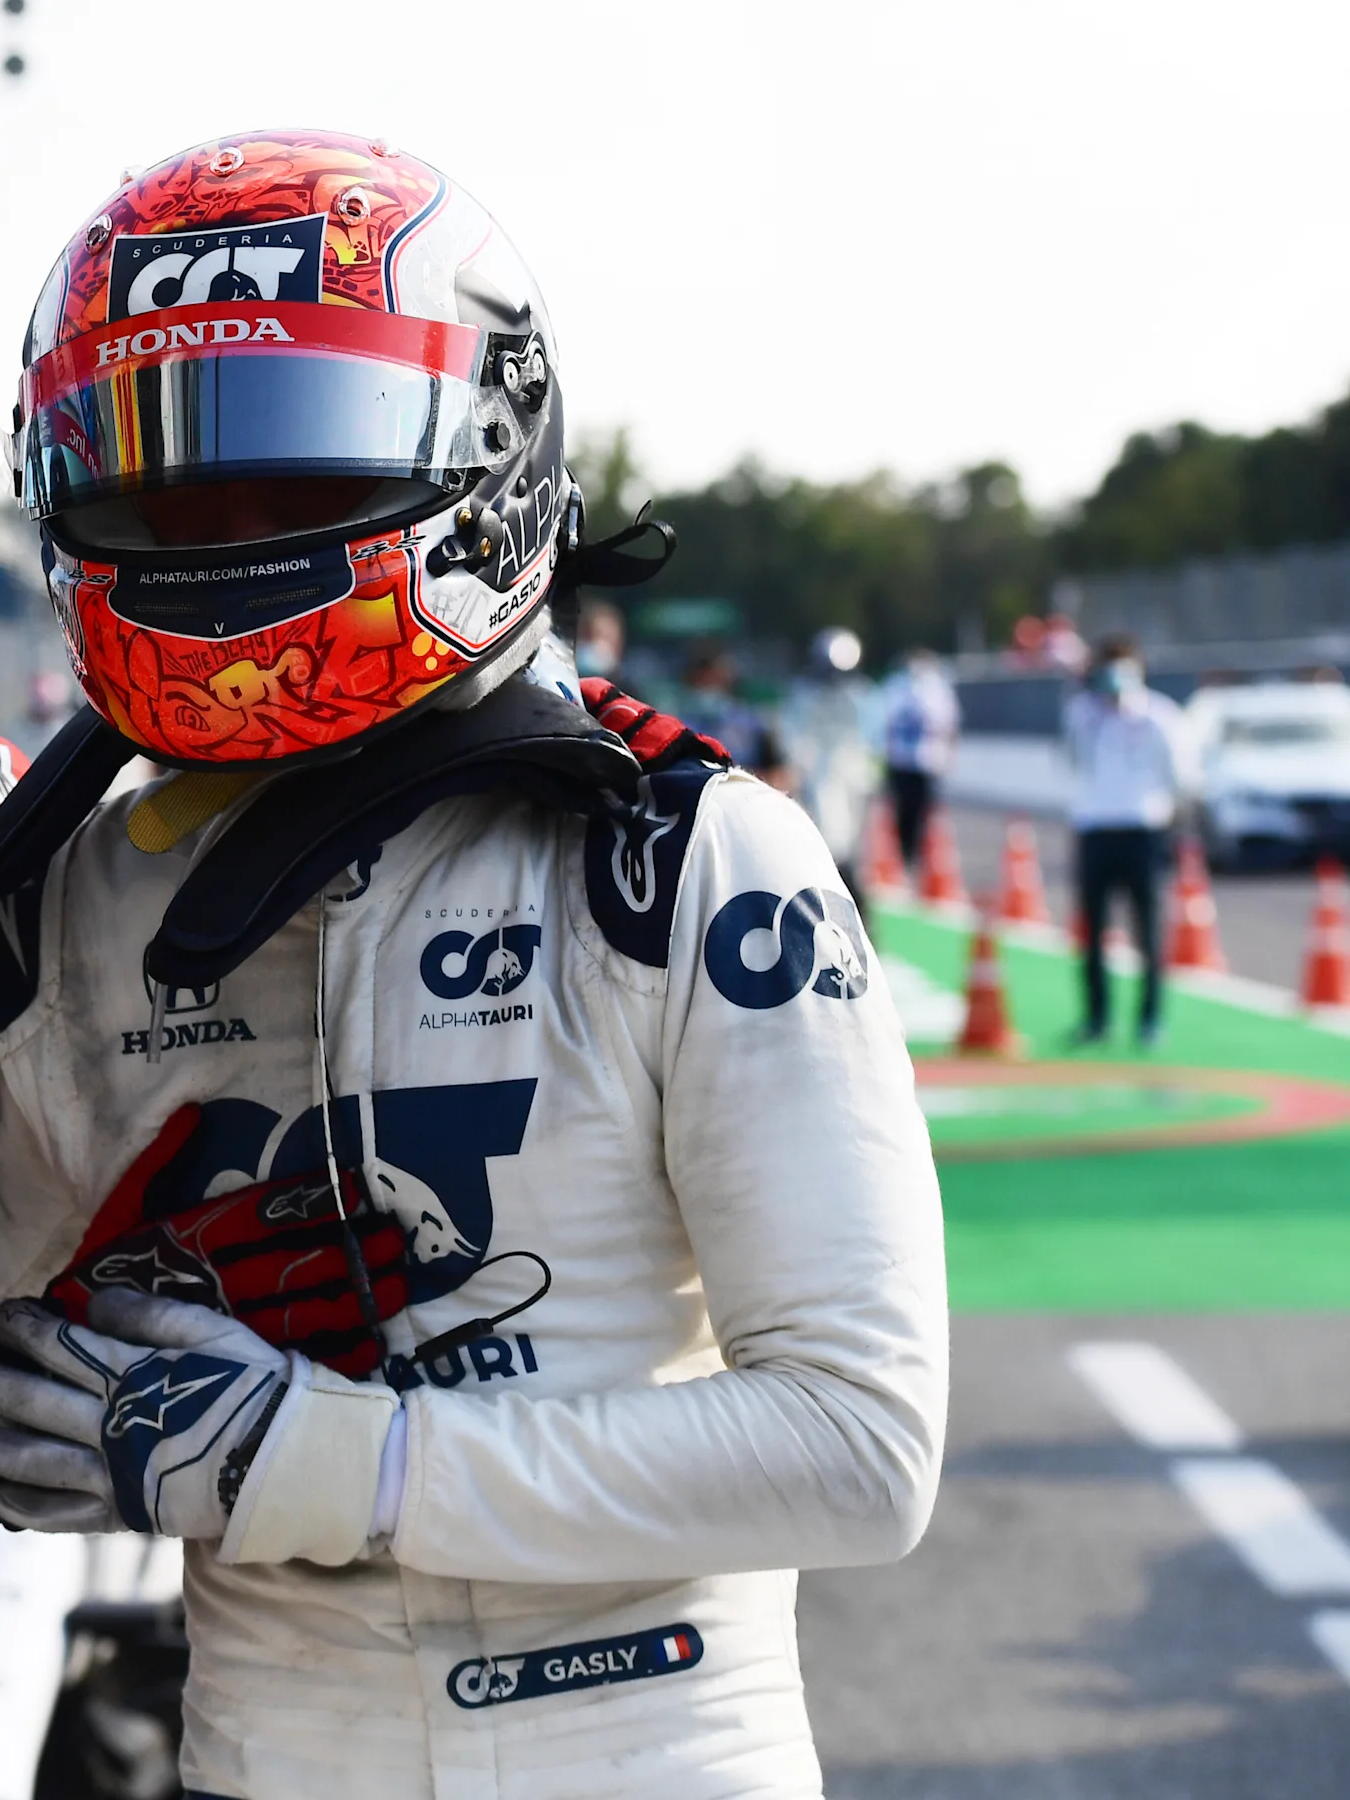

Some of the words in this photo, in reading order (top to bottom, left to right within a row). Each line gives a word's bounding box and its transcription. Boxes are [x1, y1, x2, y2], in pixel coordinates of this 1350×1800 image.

[132, 234, 293, 258] SCUDERIA
[95, 317, 295, 368] HONDA
[139, 558, 311, 584] ALPHATAURI.COM/FASHION
[425, 905, 535, 918] SCUDERIA
[419, 1004, 533, 1029] ALPHATAURI
[543, 1646, 638, 1683] GASLY
